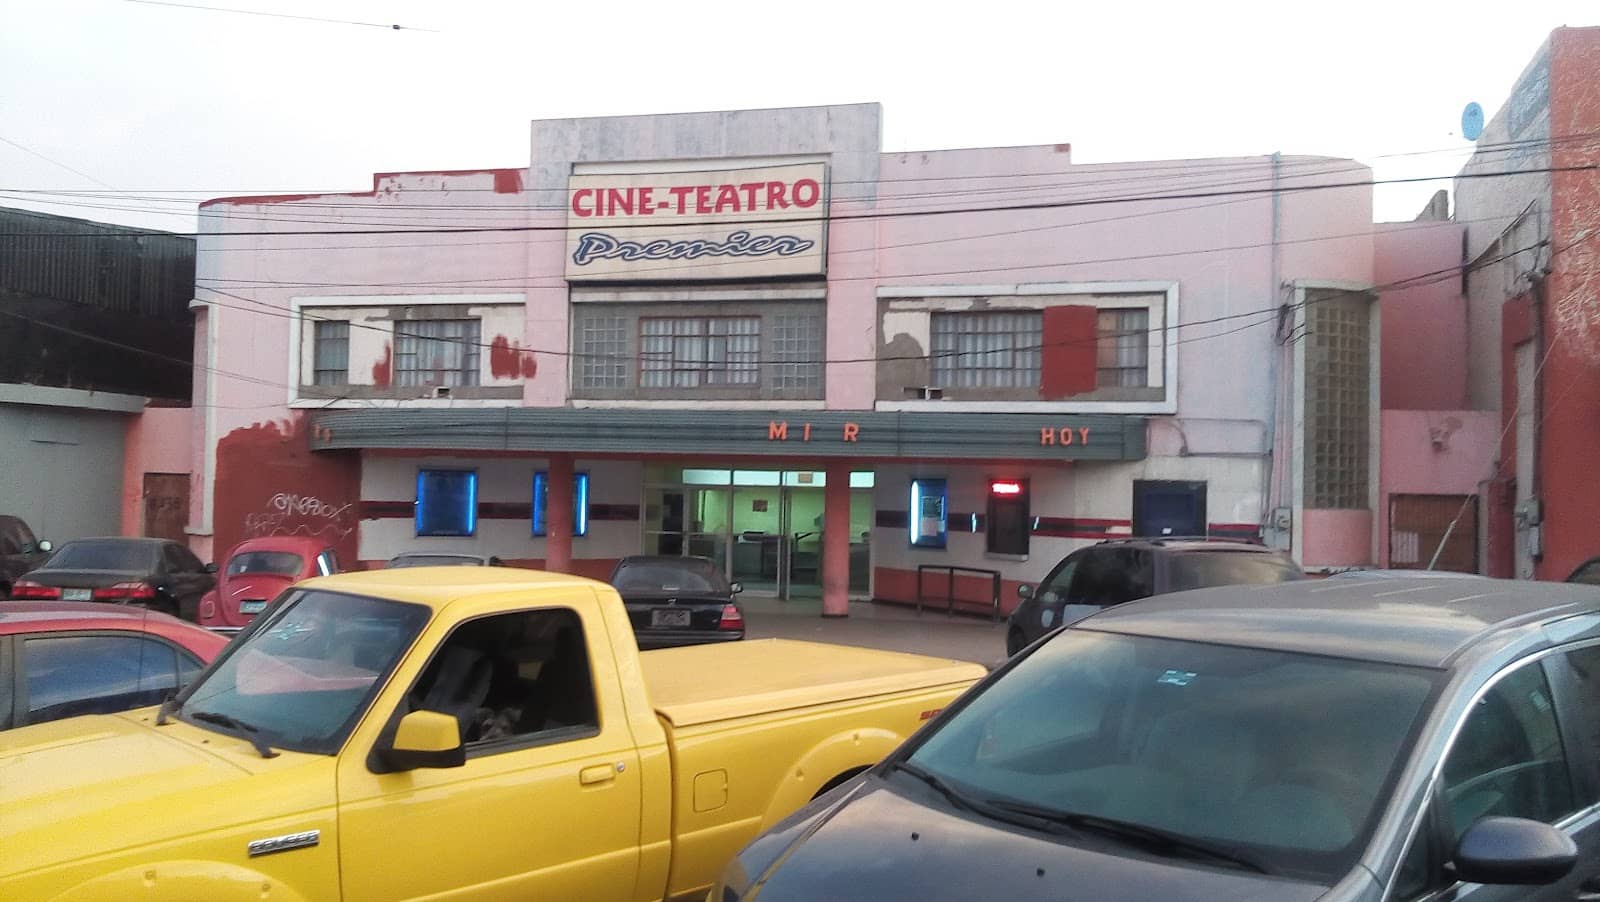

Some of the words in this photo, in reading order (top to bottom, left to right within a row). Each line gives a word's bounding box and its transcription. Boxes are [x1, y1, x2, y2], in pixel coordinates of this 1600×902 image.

[572, 178, 820, 218] CINE-TEATRO
[572, 230, 815, 266] Premier
[1040, 426, 1090, 447] HOY
